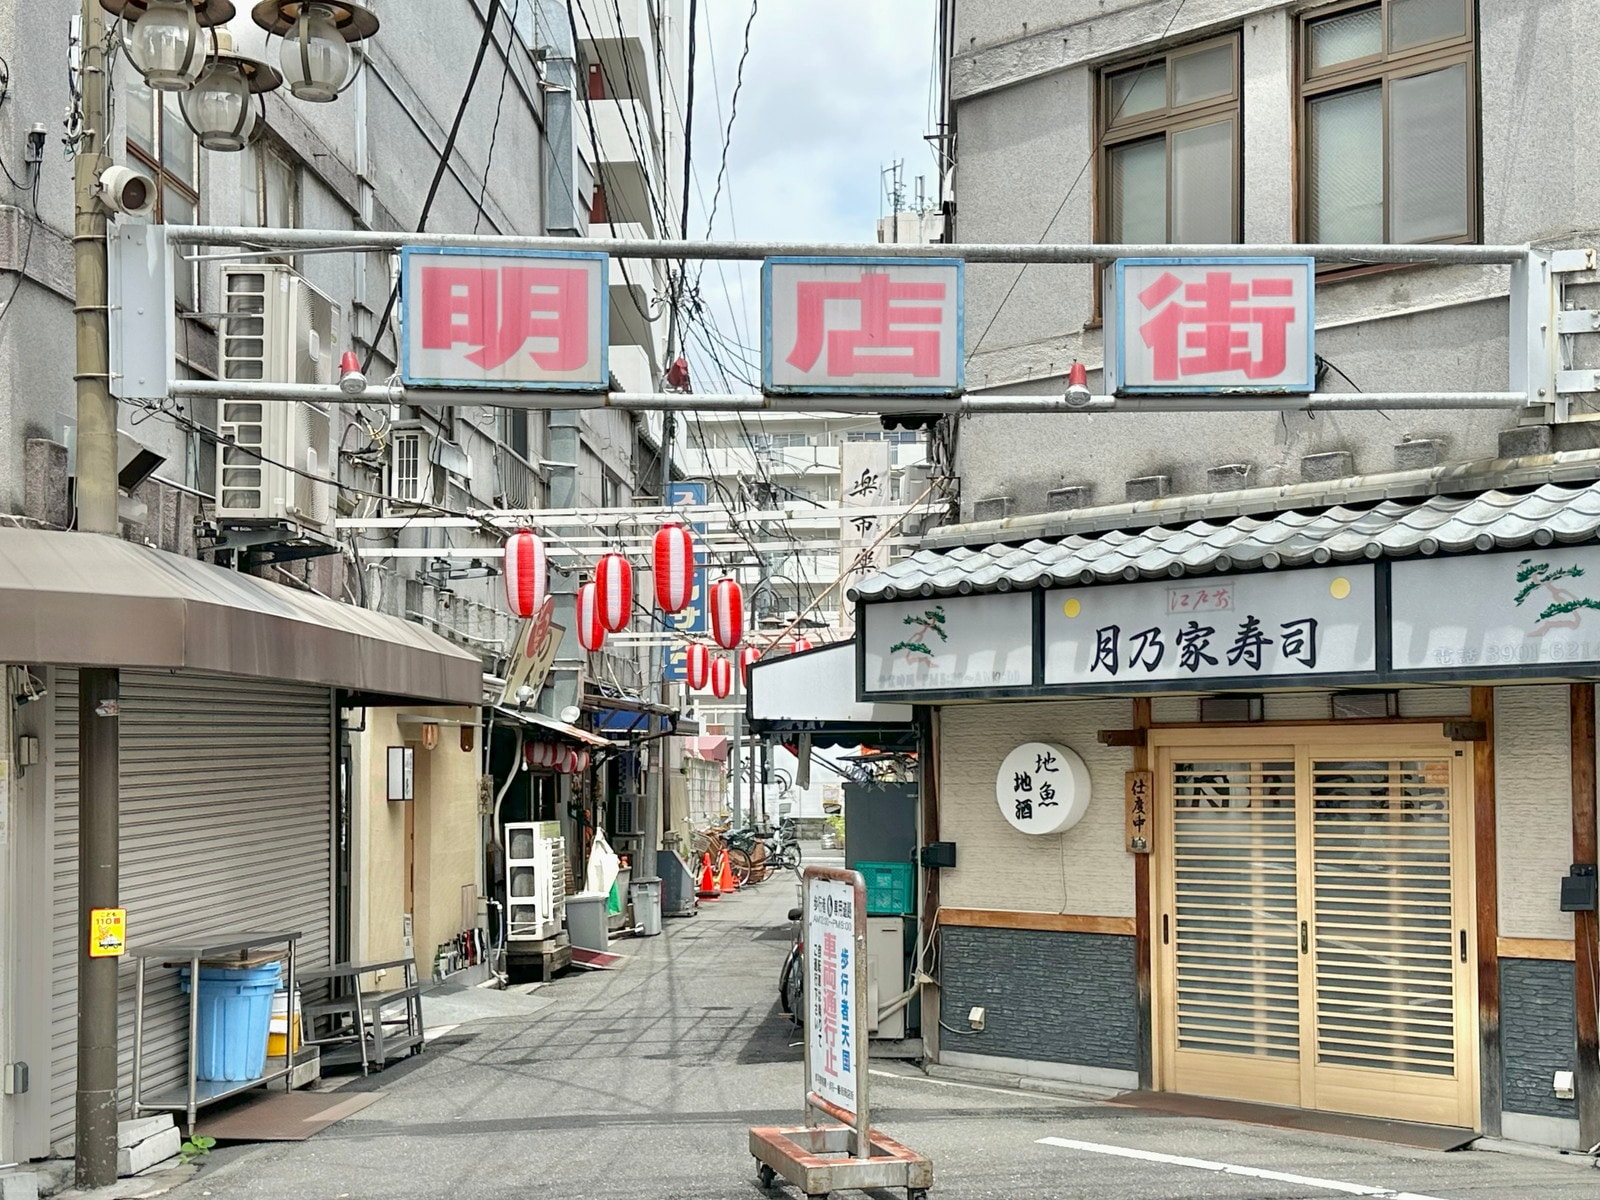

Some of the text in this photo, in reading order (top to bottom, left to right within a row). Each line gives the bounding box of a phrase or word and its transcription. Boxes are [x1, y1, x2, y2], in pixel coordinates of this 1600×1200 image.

[422, 266, 1296, 380] 明 店 街
[1090, 615, 1319, 676] 月乃家寿司
[1433, 646, 1481, 665] 電話
[1013, 771, 1033, 820] 地酒
[1035, 752, 1059, 808] 地魚
[1131, 779, 1147, 833] 仕度中
[823, 932, 838, 1077] 車両通行止
[840, 947, 851, 1073] 歩行者天国
